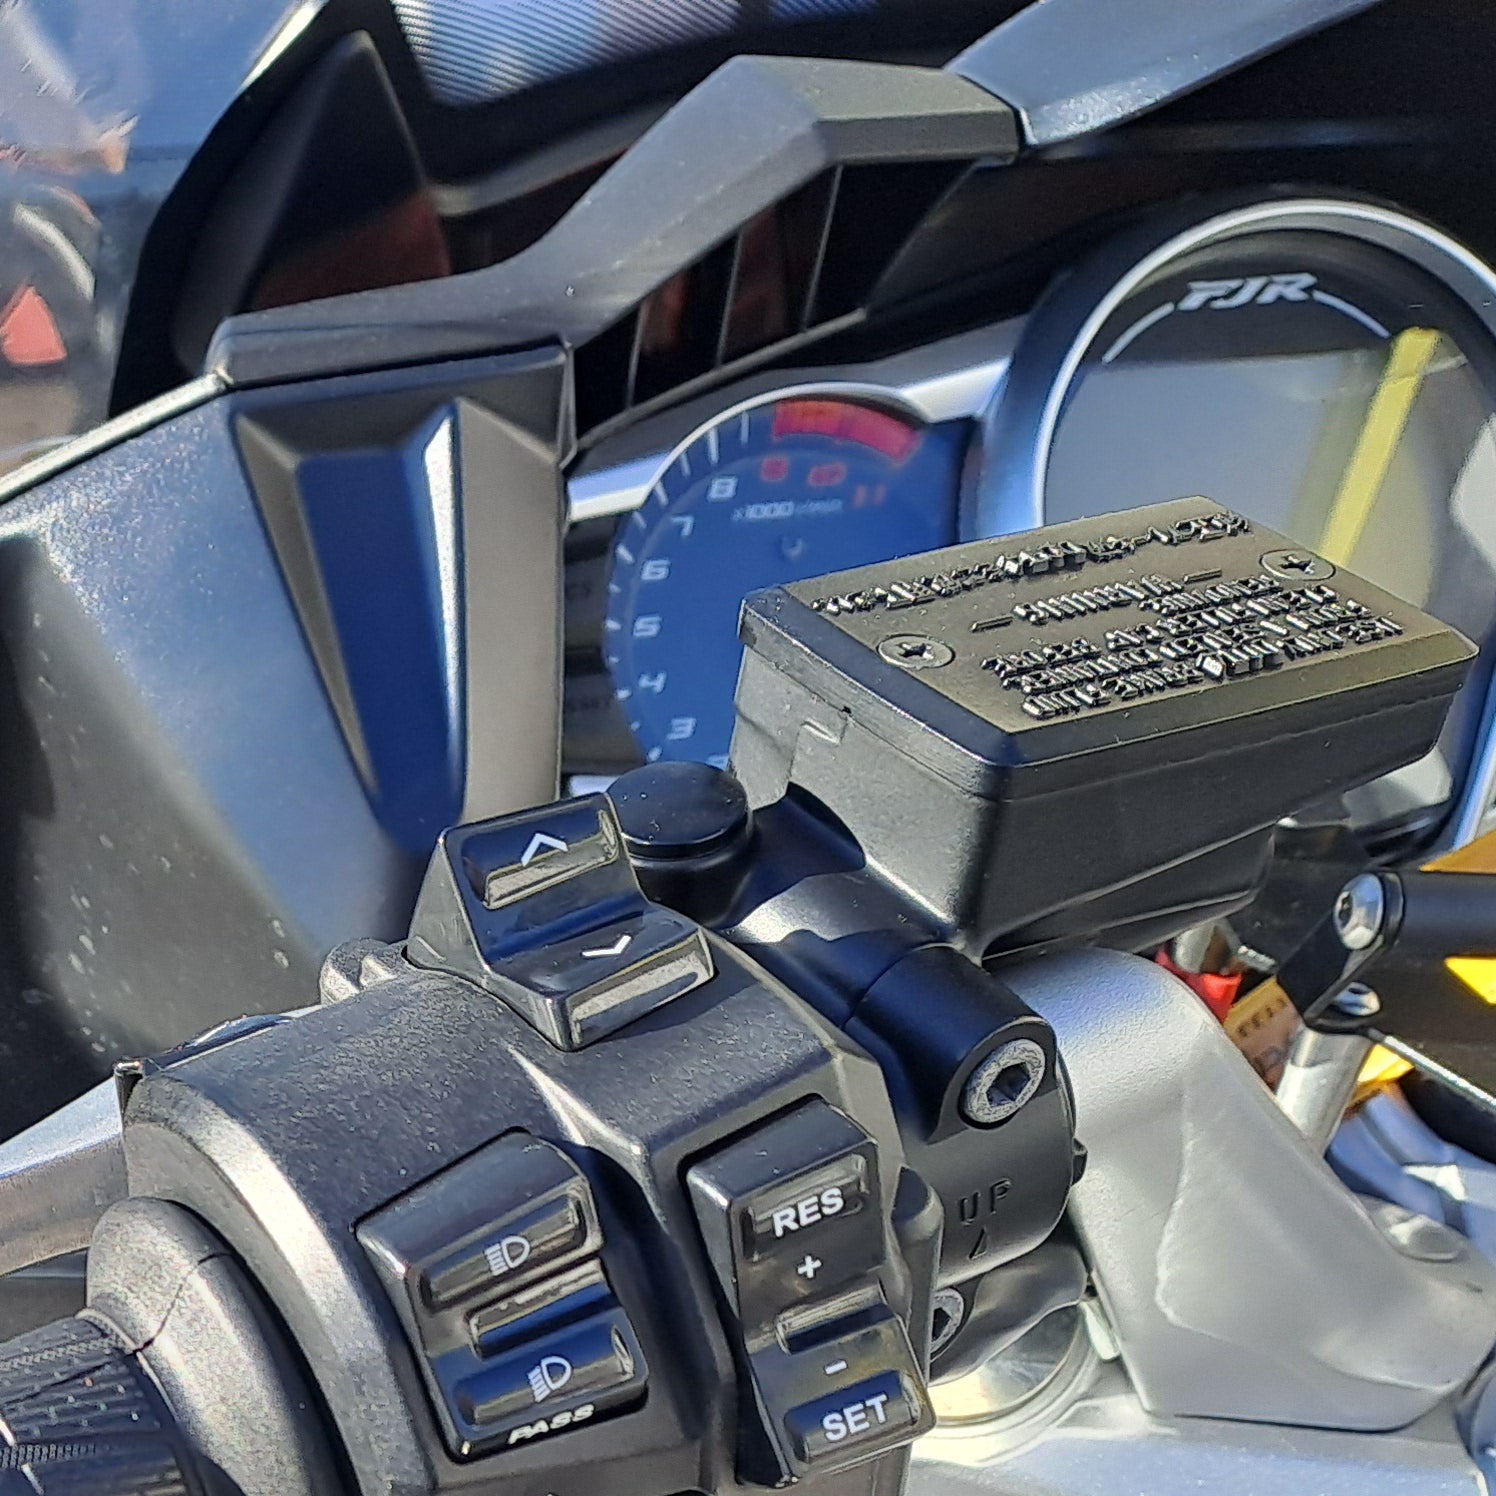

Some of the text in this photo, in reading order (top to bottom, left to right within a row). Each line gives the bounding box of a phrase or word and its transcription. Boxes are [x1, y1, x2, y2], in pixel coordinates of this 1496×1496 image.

[1175, 273, 1316, 311] FJR
[708, 476, 737, 501] 8
[671, 515, 694, 537] 7
[641, 560, 670, 581] 6
[633, 617, 661, 638] 5
[639, 672, 667, 693] 4
[667, 717, 697, 740] 3
[772, 1188, 845, 1238] RES
[958, 1180, 1010, 1224] UP
[507, 1404, 594, 1445] PASS
[824, 1393, 890, 1443] SET
